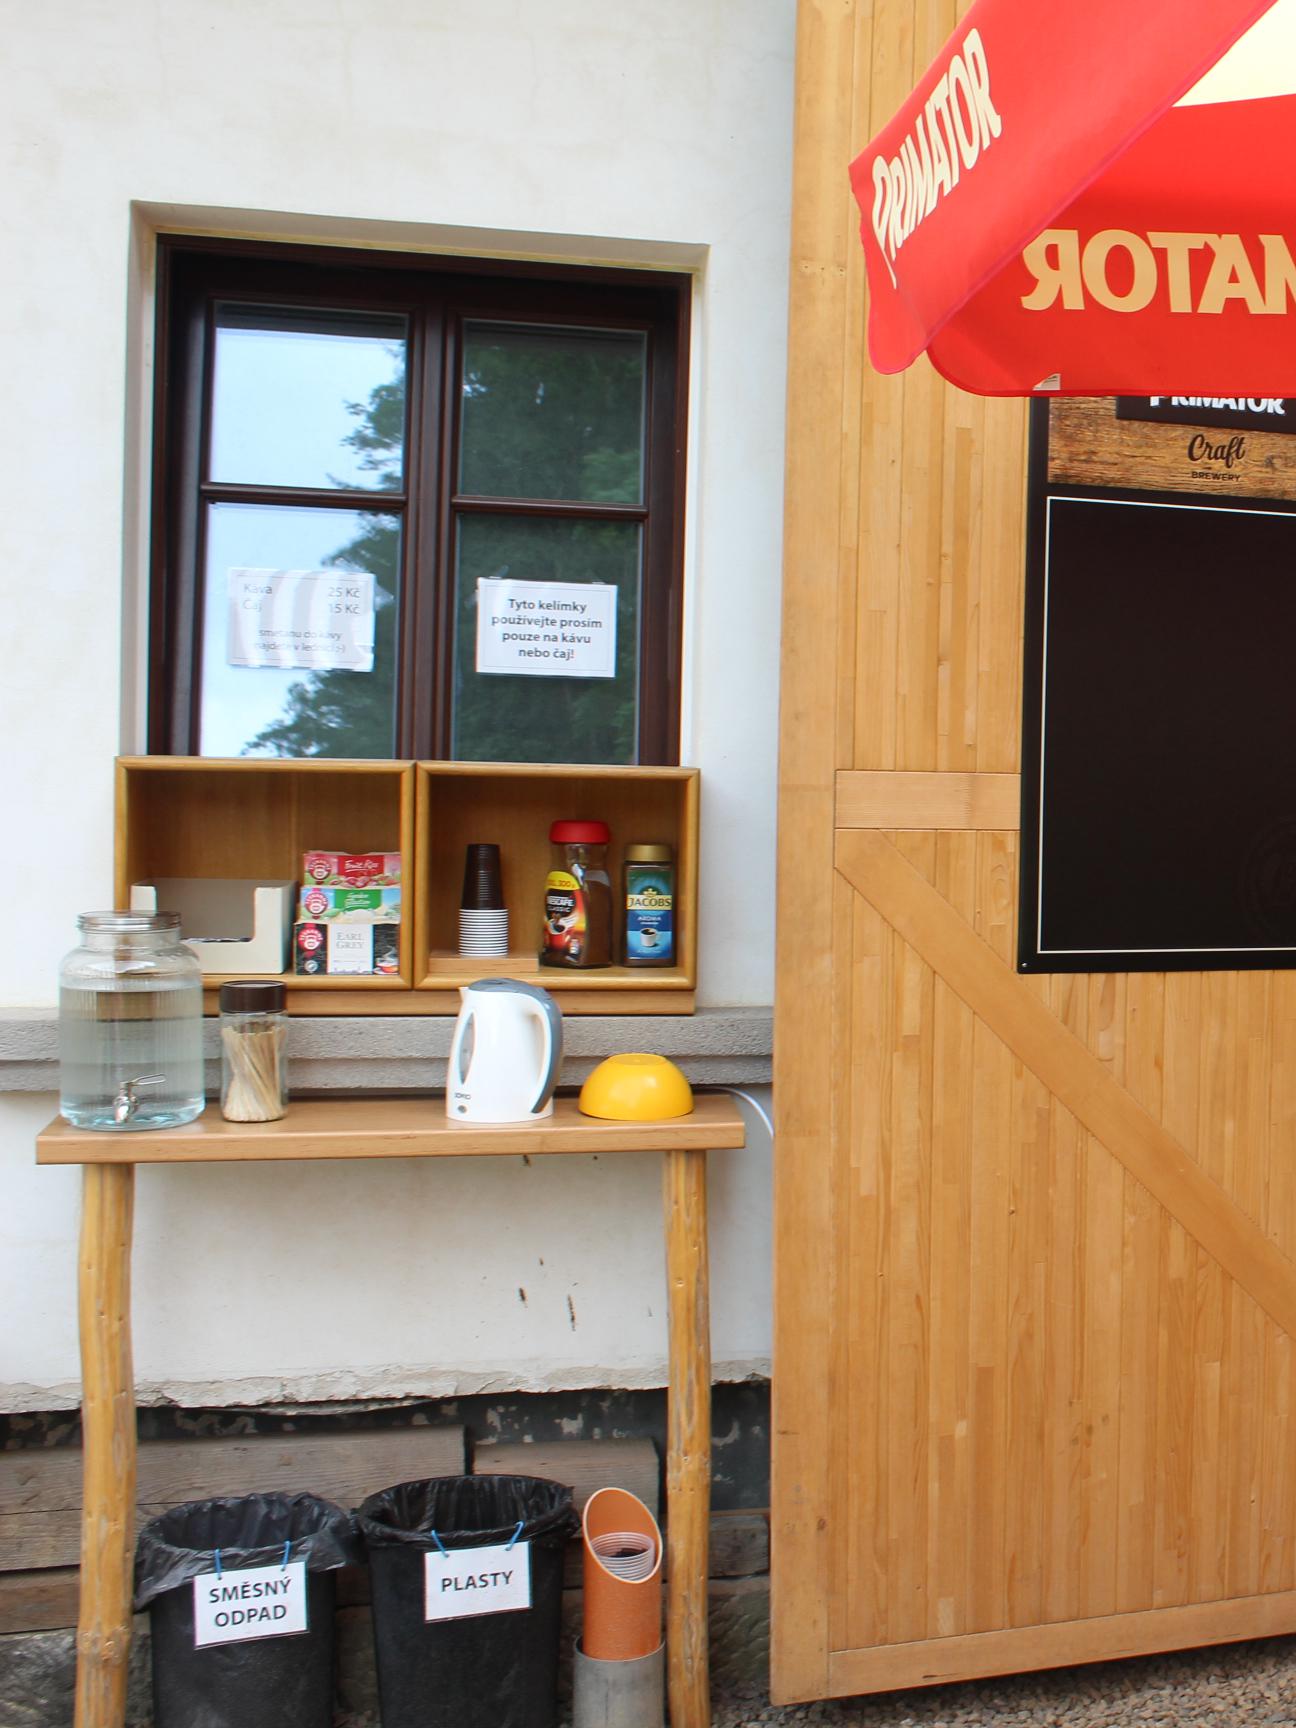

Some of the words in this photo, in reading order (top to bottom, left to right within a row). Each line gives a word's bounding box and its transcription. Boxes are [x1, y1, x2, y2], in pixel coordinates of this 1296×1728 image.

[1187, 434, 1246, 469] Craft
[1191, 471, 1241, 481] BREWERY
[328, 586, 343, 598] 25
[345, 587, 360, 598] Kč
[345, 603, 360, 615] Kč
[508, 599, 535, 611] Tyto
[502, 632, 540, 642] pouze
[543, 633, 558, 642] na
[561, 632, 592, 643] kávu
[518, 647, 551, 658] nebo
[552, 649, 575, 661] čaj!
[628, 897, 672, 908] JACOBS
[336, 932, 361, 940] EARL
[336, 941, 364, 949] GREY
[441, 1570, 514, 1592] PLASTY
[209, 1576, 292, 1603] SMĚSNÝ
[215, 1604, 287, 1627] ODPAD
